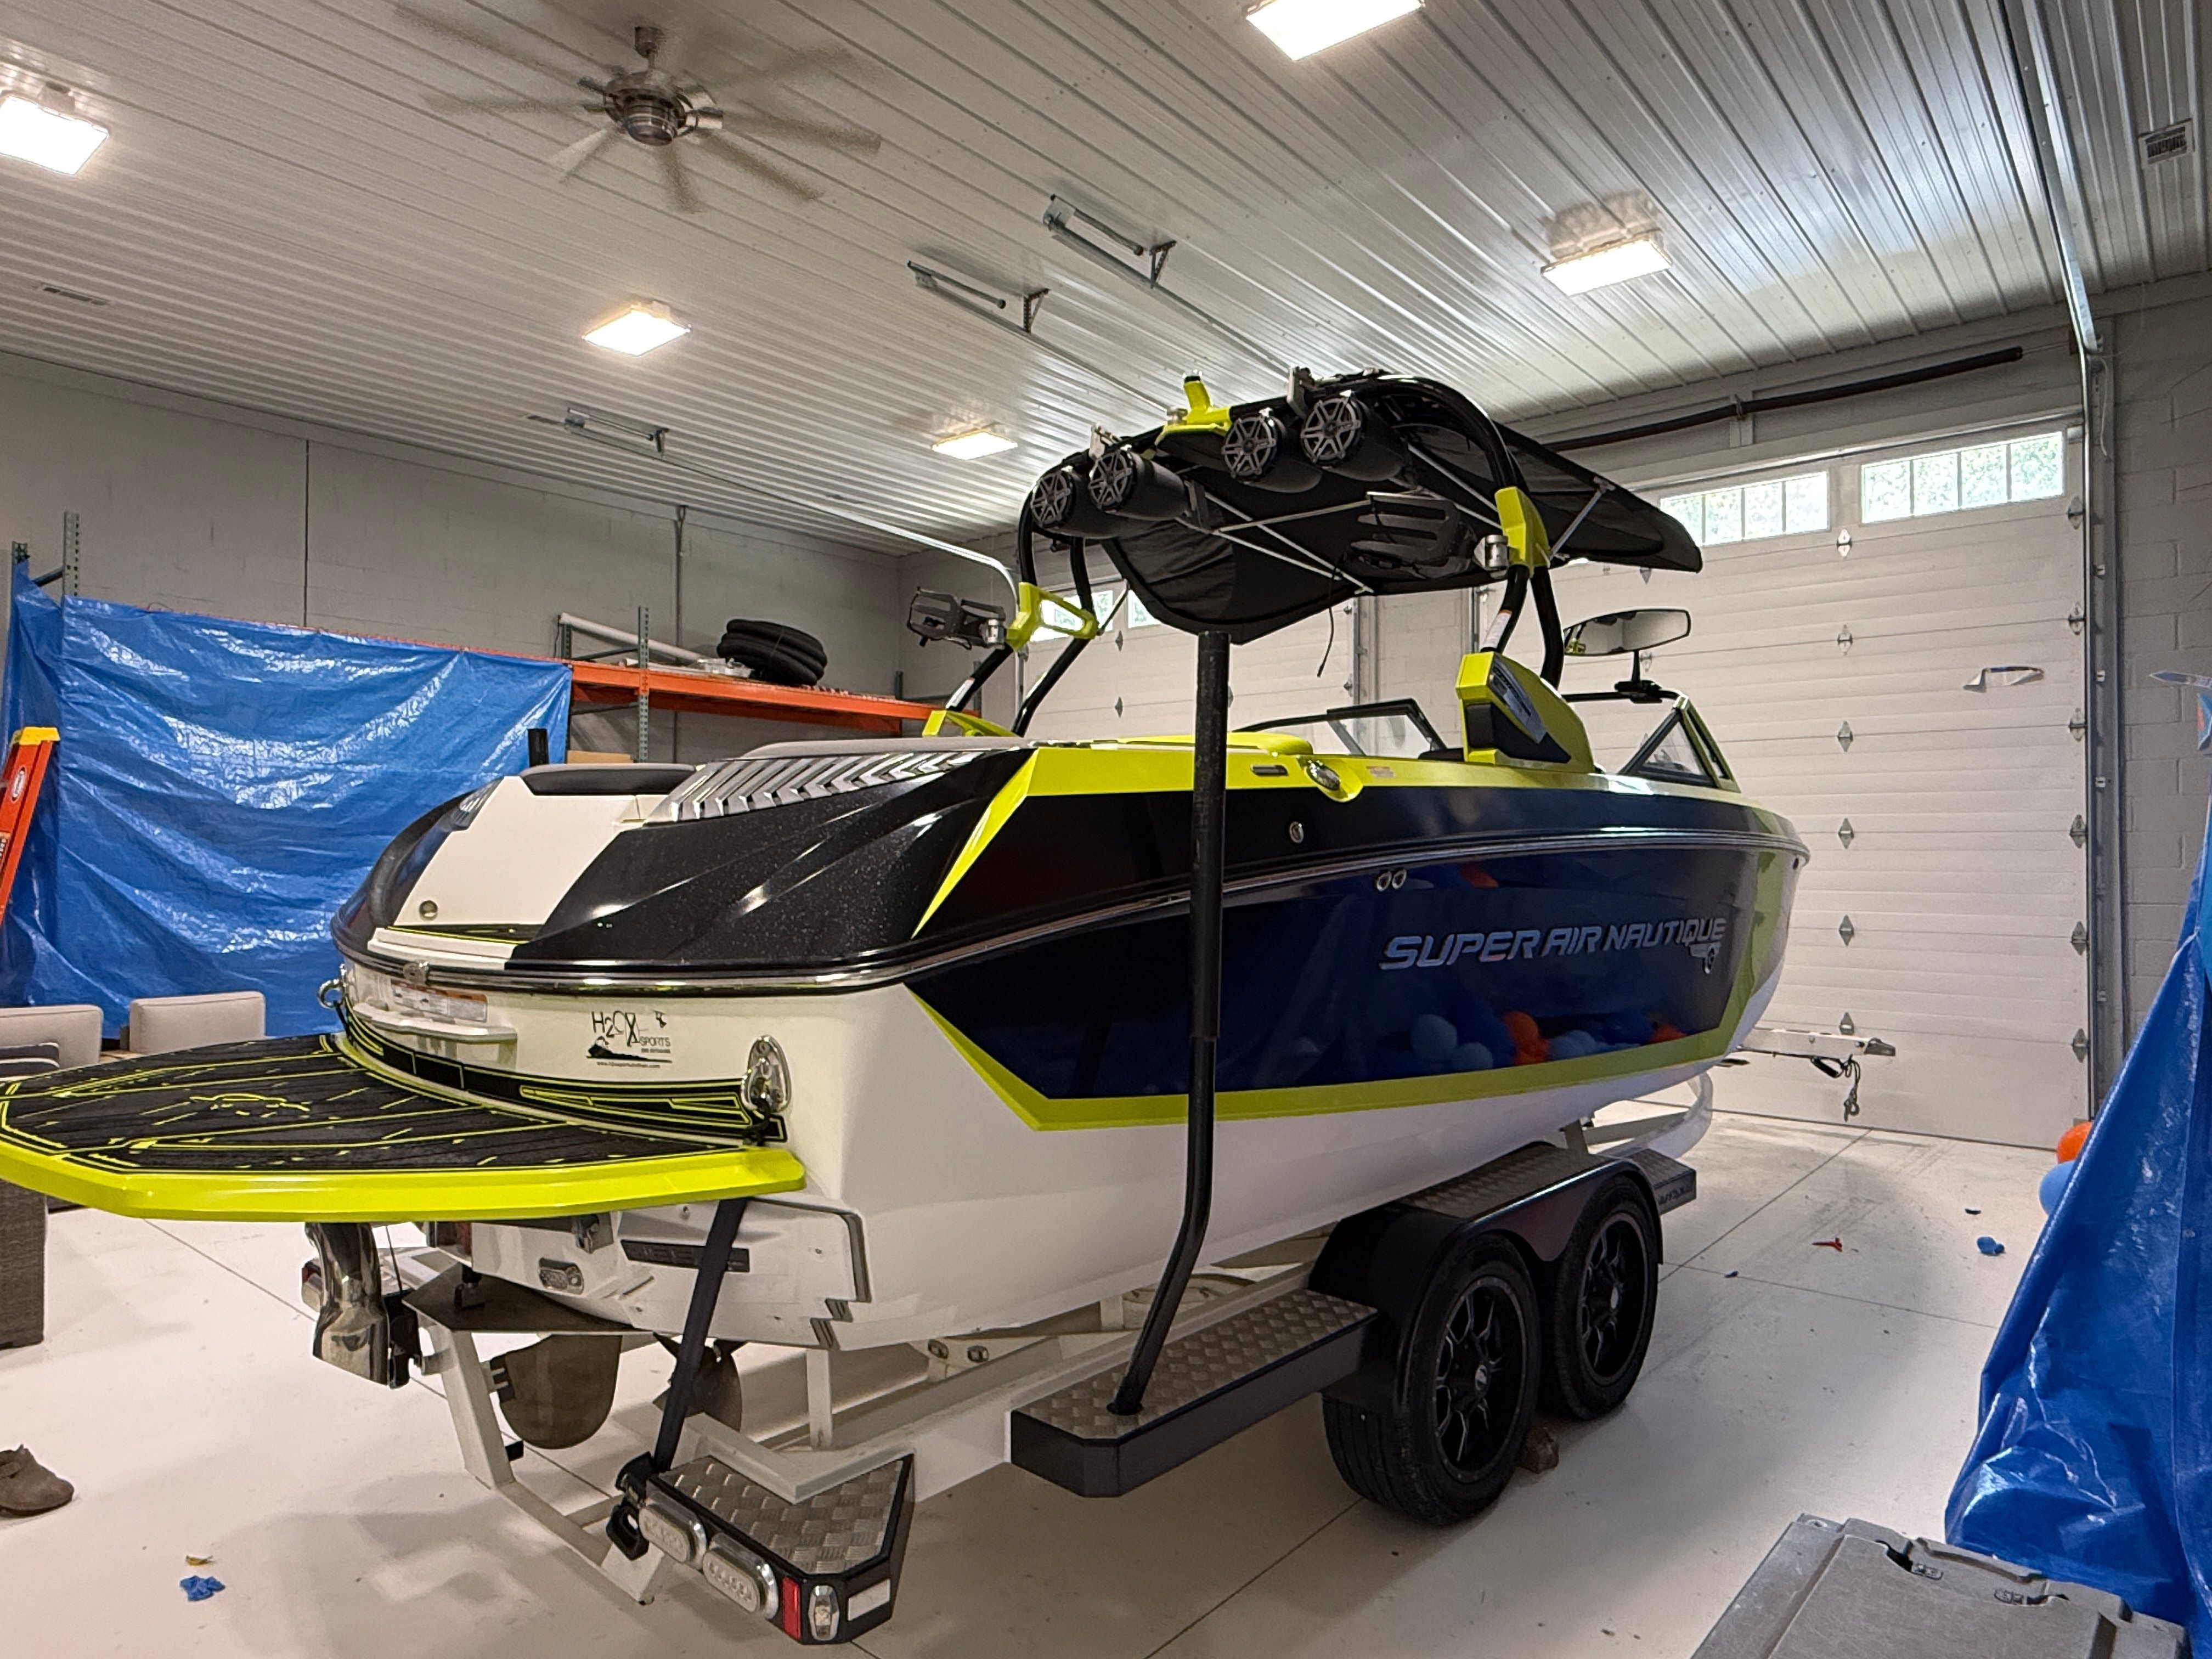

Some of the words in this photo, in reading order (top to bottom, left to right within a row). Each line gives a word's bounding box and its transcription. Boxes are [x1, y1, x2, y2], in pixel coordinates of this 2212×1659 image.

[1379, 929, 1541, 970] SUPER
[1541, 926, 1603, 957] AIR
[1602, 917, 1726, 951] NAUTIQUE
[640, 1036, 671, 1047] SPORTS
